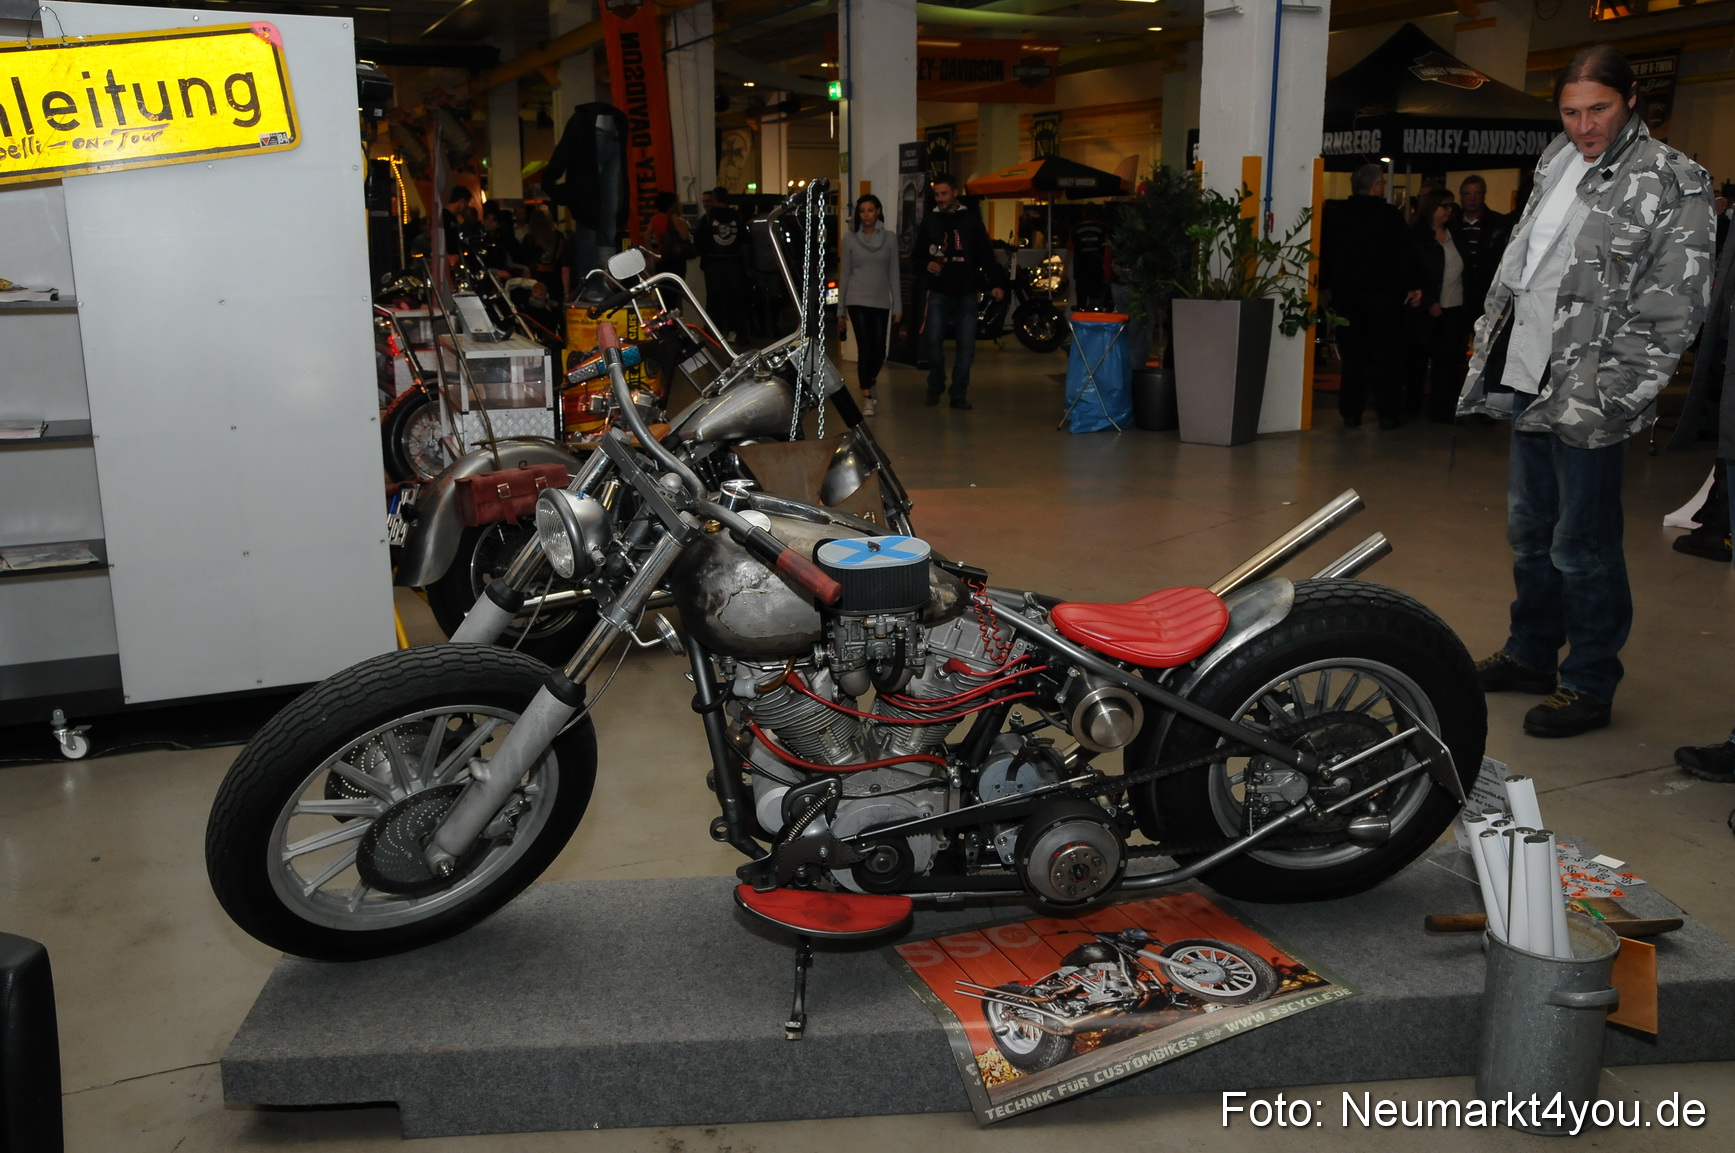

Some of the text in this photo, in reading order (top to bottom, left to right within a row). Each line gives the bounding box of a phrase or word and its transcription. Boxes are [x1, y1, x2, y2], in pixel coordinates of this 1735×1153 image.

[1402, 128, 1548, 155] HARLEY-DAVIDSON
[984, 1089, 1054, 1121] TECHNIK
[1057, 1076, 1090, 1097] FÜR
[1093, 1036, 1199, 1084] CUSTOMBIKES
